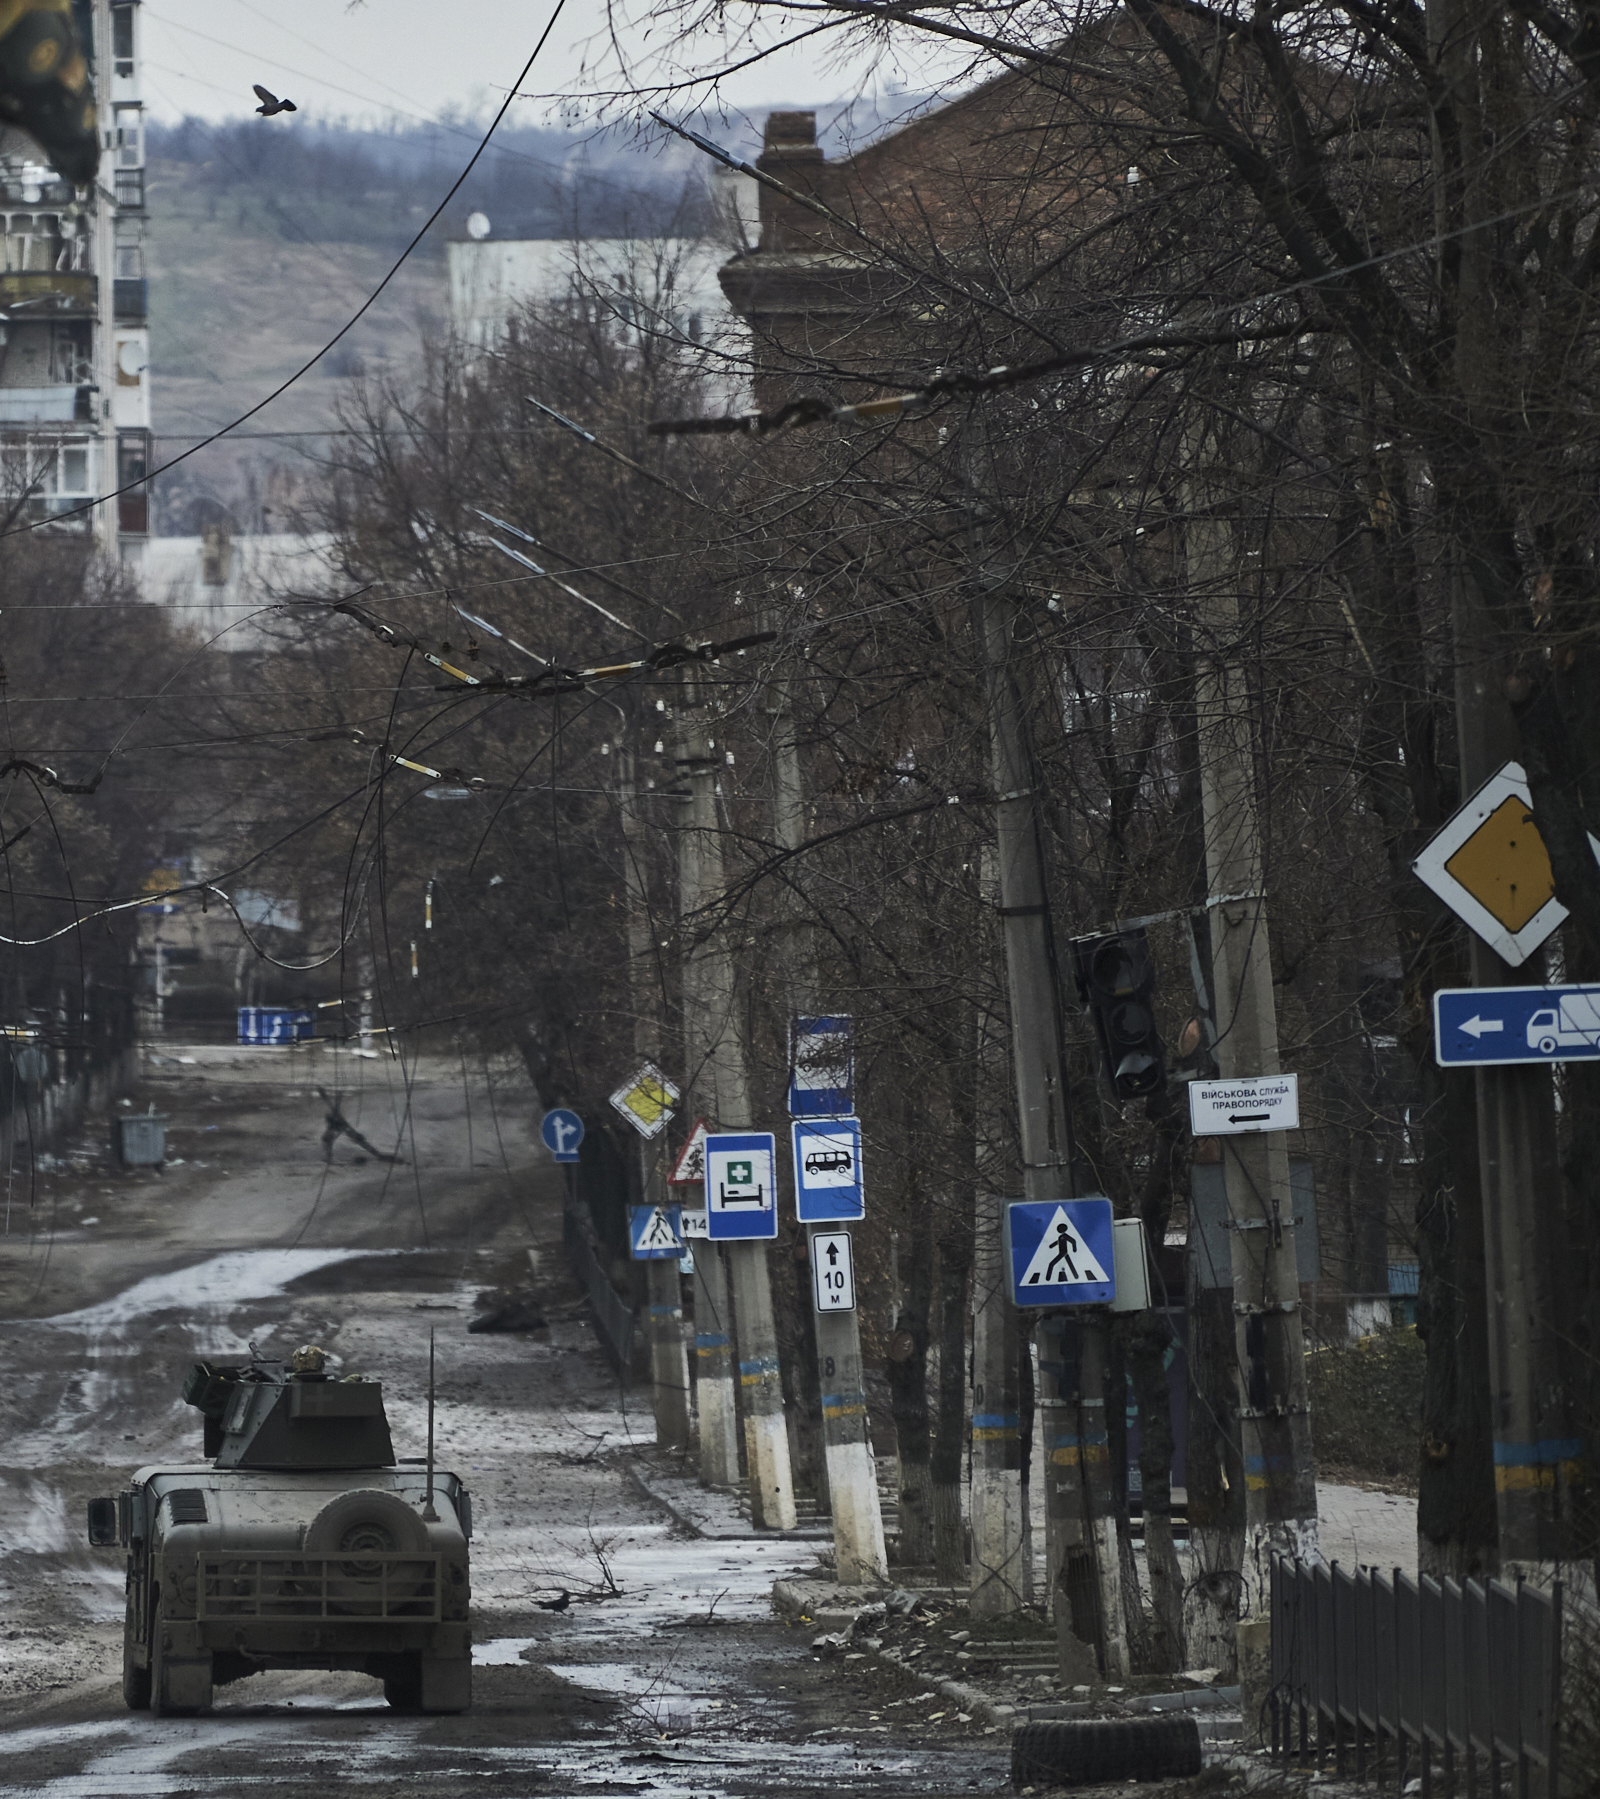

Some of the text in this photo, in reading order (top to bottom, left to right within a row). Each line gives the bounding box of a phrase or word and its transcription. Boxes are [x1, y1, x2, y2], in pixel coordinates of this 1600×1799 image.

[1201, 1086, 1289, 1099] ВІЙСЬКОВА СЛУЖБА
[1212, 1097, 1283, 1109] ПРАВОПОРЯДКУ
[824, 1271, 844, 1289] 10
